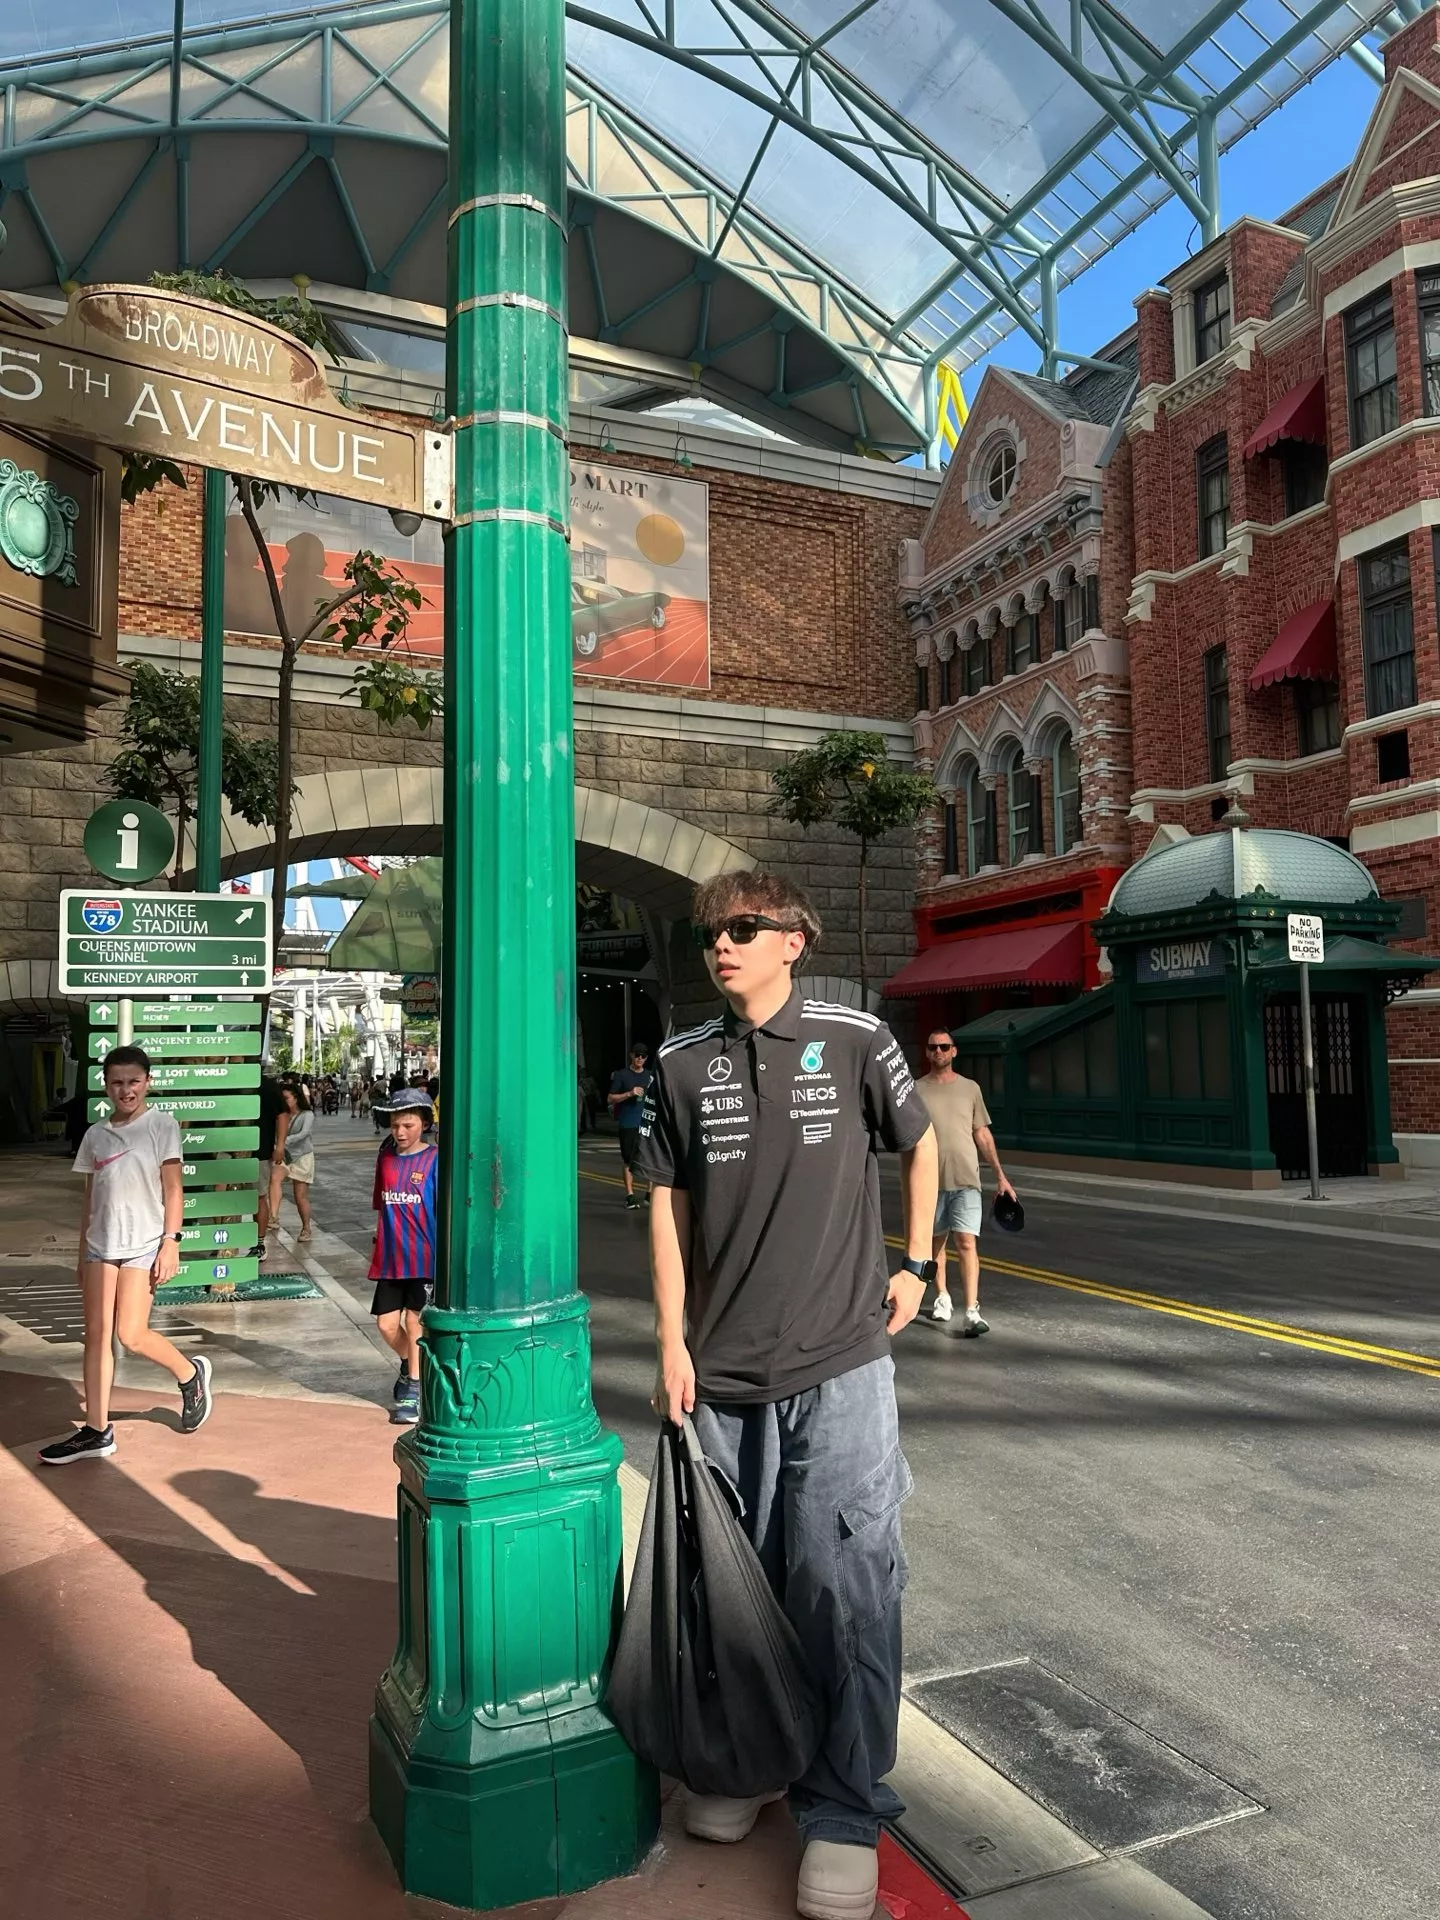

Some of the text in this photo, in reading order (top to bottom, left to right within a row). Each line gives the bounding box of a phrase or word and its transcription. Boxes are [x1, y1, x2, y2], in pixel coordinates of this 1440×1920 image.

[125, 305, 276, 376] BROADWAY
[125, 382, 386, 486] AVENUE
[584, 473, 648, 498] MART
[132, 902, 197, 918] YANKEE
[89, 914, 116, 926] 278
[1300, 918, 1311, 927] NO
[132, 919, 209, 934] STADIUM
[1290, 925, 1320, 940] PARKING
[79, 940, 196, 953] QUEENS MIDTOWN
[1292, 945, 1320, 954] BLOCK
[97, 951, 148, 963] TUNNEL
[232, 954, 257, 965] 3 mi
[1150, 940, 1212, 972] SUBWAY
[83, 972, 199, 984] KENNEDY AIRPORT
[141, 1036, 231, 1045] ANCIENT EGYPT
[165, 1069, 190, 1077] LOST
[194, 1068, 228, 1076] WORLD
[794, 1073, 832, 1082] PETRONAS
[791, 1086, 837, 1103] INEOS
[716, 1096, 744, 1111] UBS
[798, 1108, 840, 1117] TeamViewer
[703, 1115, 750, 1126] CROWDSTRIKE
[711, 1133, 750, 1143] Snapdragon
